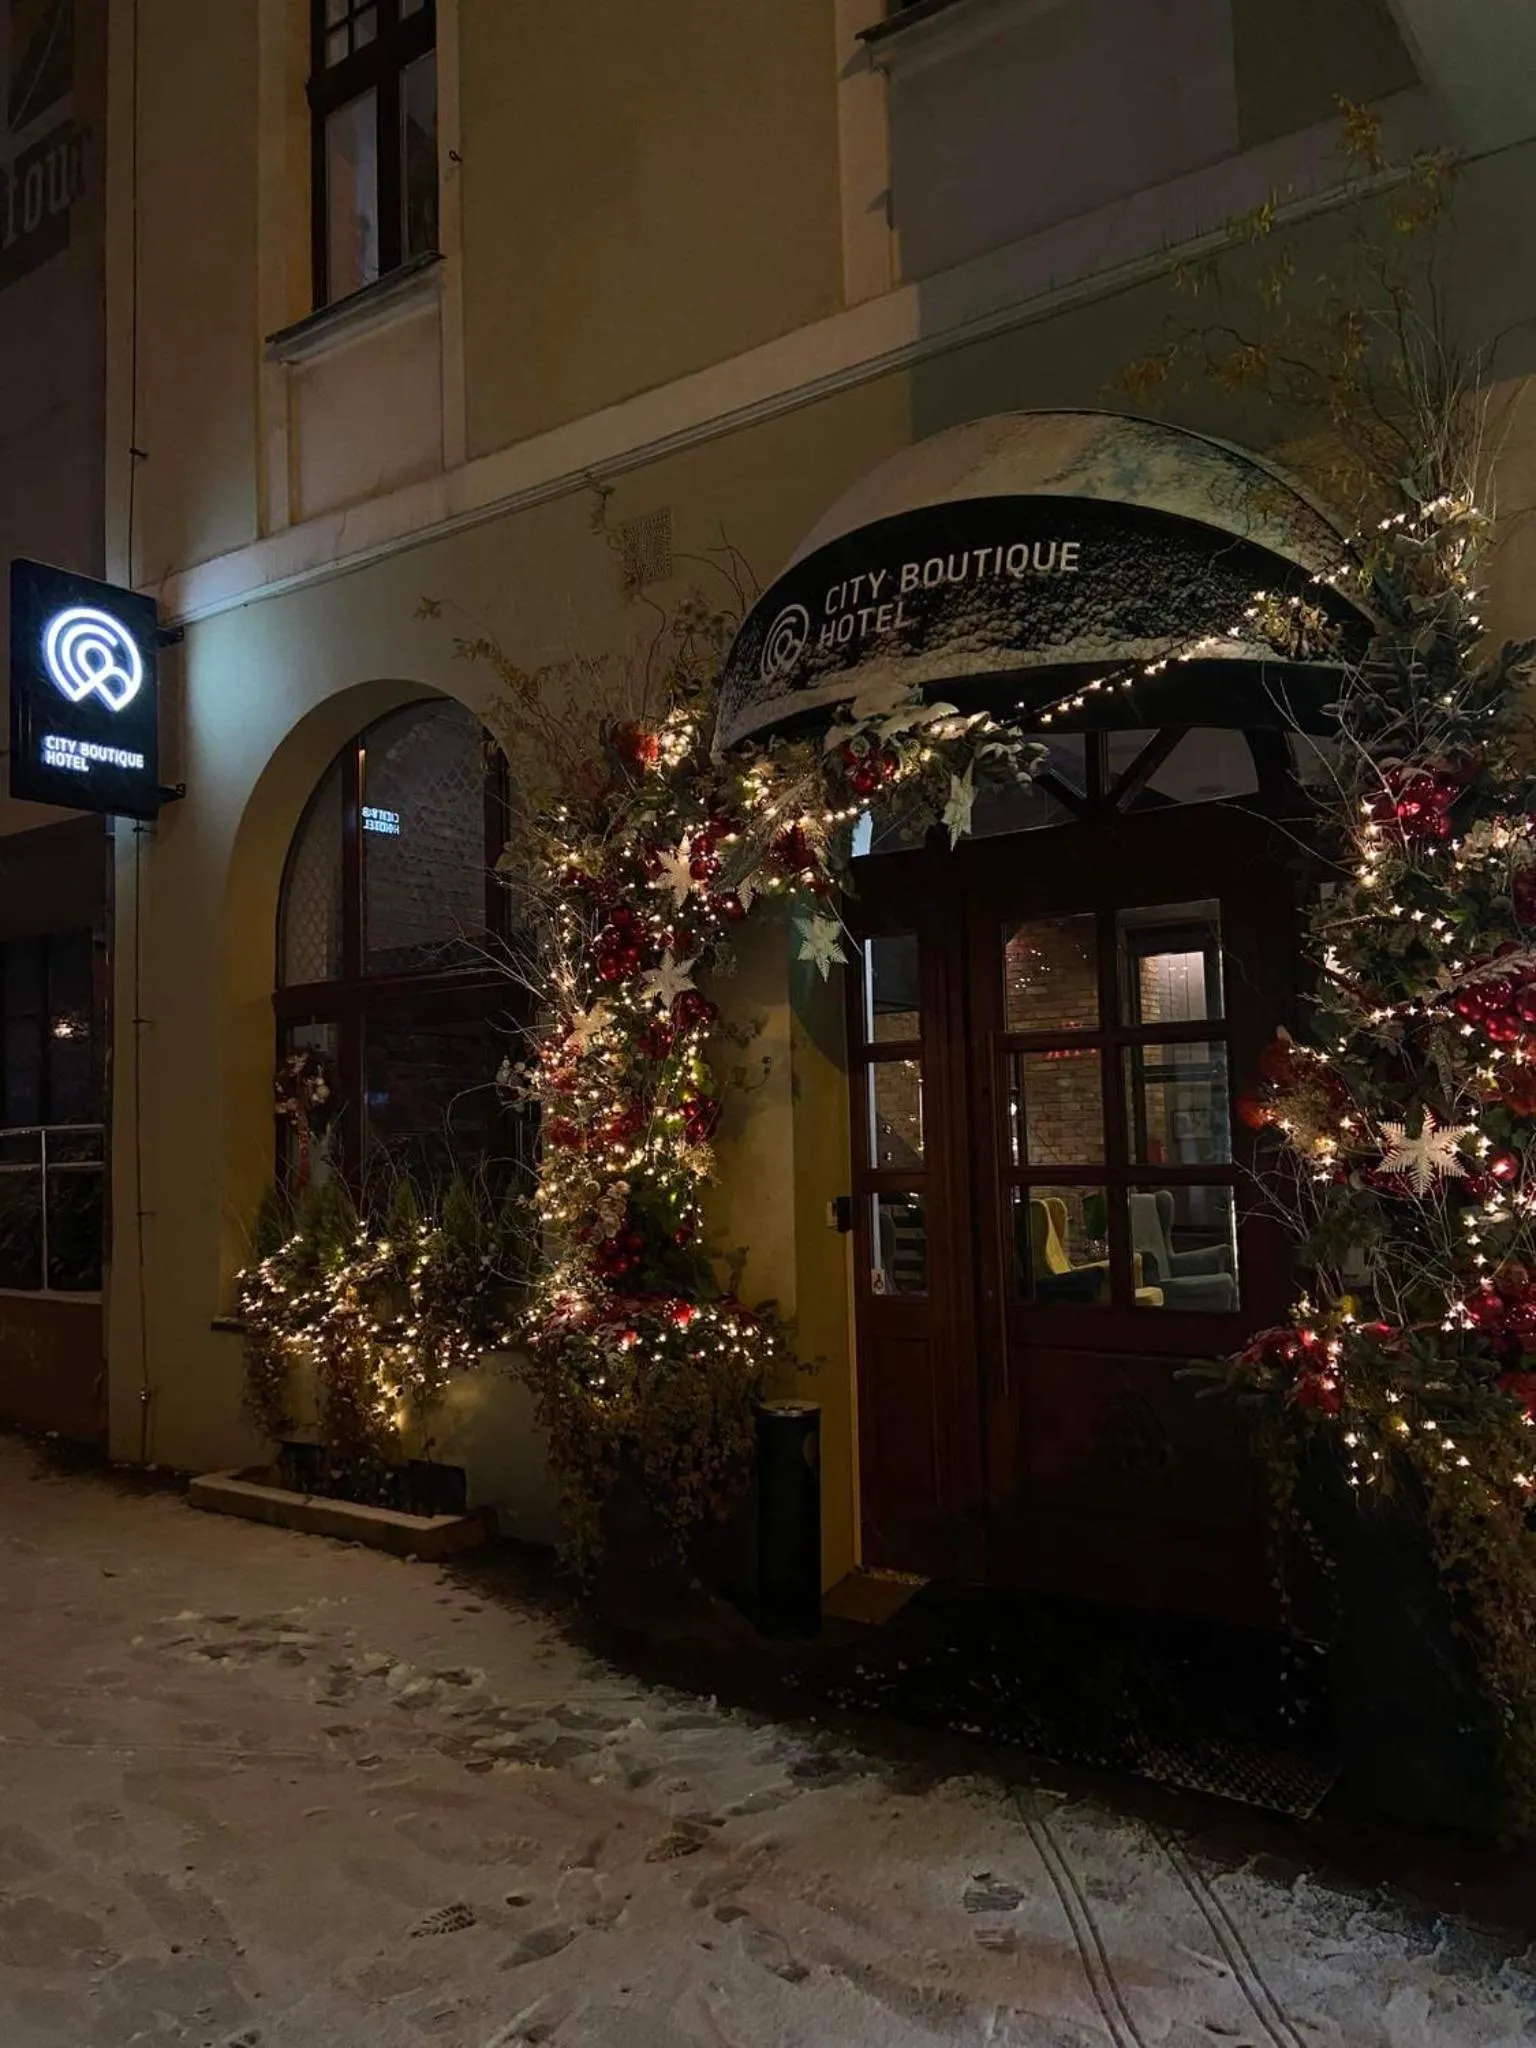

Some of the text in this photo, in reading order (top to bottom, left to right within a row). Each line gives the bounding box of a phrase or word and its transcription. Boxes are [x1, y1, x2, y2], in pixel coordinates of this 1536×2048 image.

[825, 540, 1081, 616] CITY BOUTIQUE
[819, 600, 911, 648] HOTEL
[45, 735, 144, 769] CITY BOUTIQUE
[45, 750, 90, 772] HOTEL
